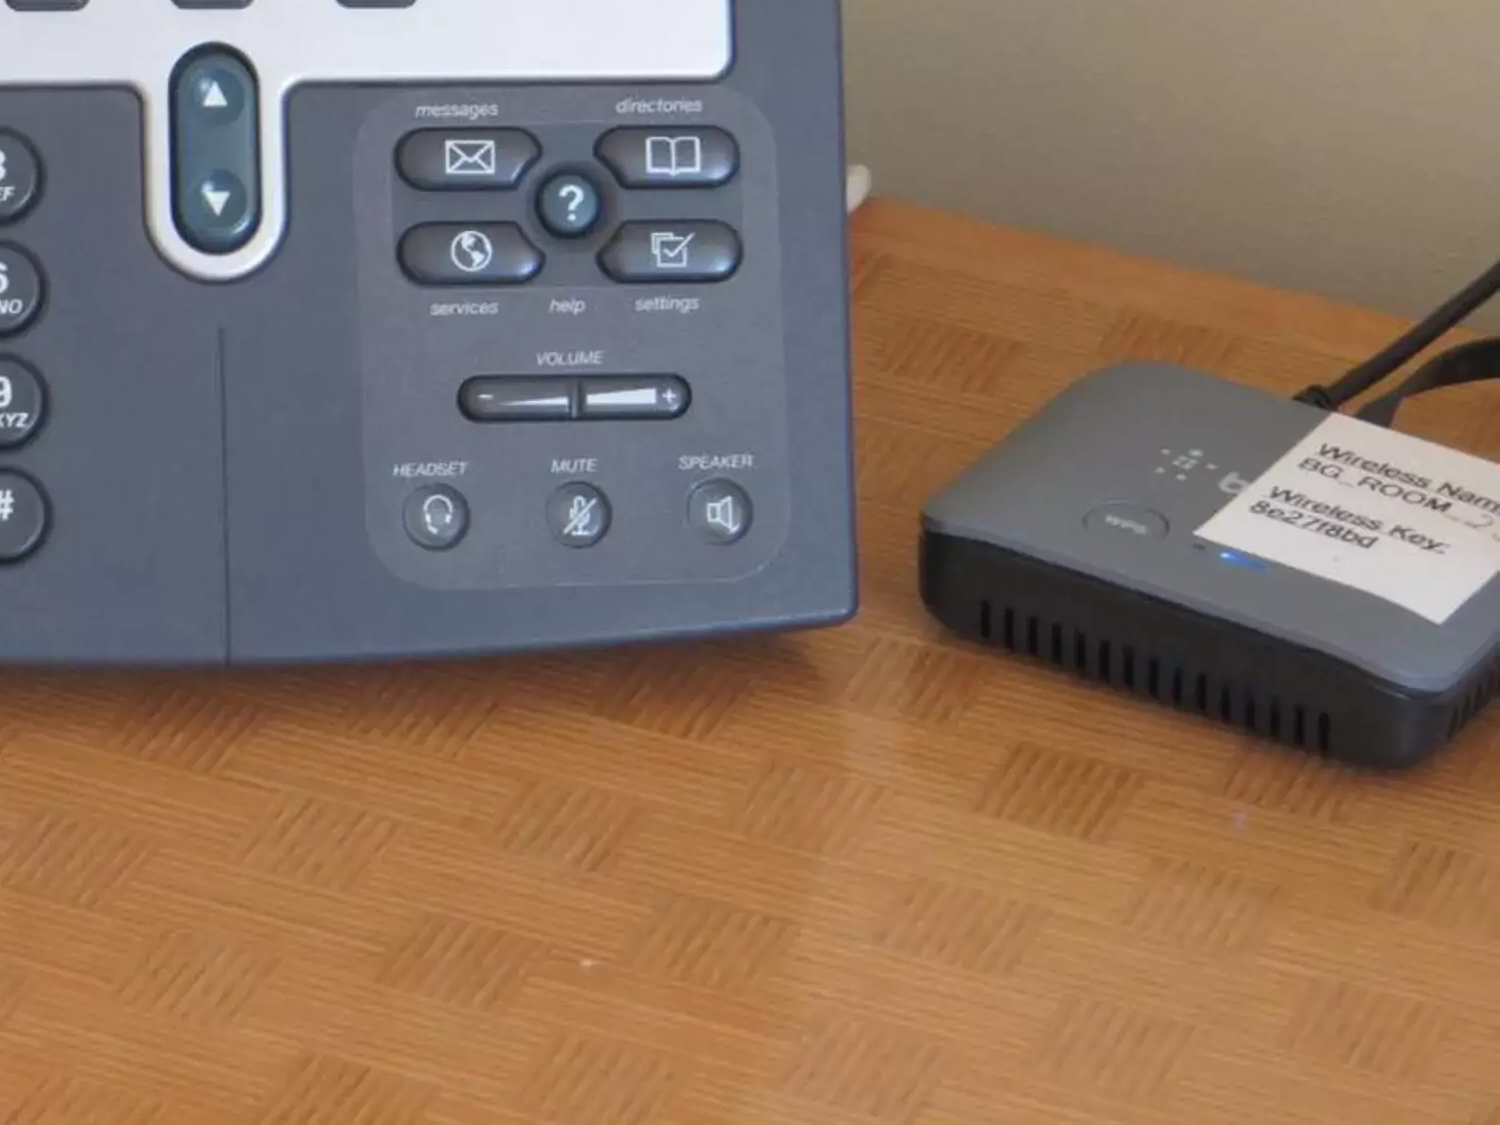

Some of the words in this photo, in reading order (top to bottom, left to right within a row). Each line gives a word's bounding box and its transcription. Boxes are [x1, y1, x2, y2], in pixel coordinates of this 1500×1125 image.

[415, 101, 499, 119] messages
[615, 97, 704, 114] directories
[430, 301, 499, 316] services
[549, 296, 586, 316] help
[635, 296, 700, 313] settings
[536, 350, 605, 366] VOLUME
[393, 461, 468, 477] HEADSET
[551, 458, 598, 474] MUTE
[678, 454, 754, 471] SPEAKER
[1317, 442, 1433, 490] Wireless
[1270, 484, 1384, 531] Wireless
